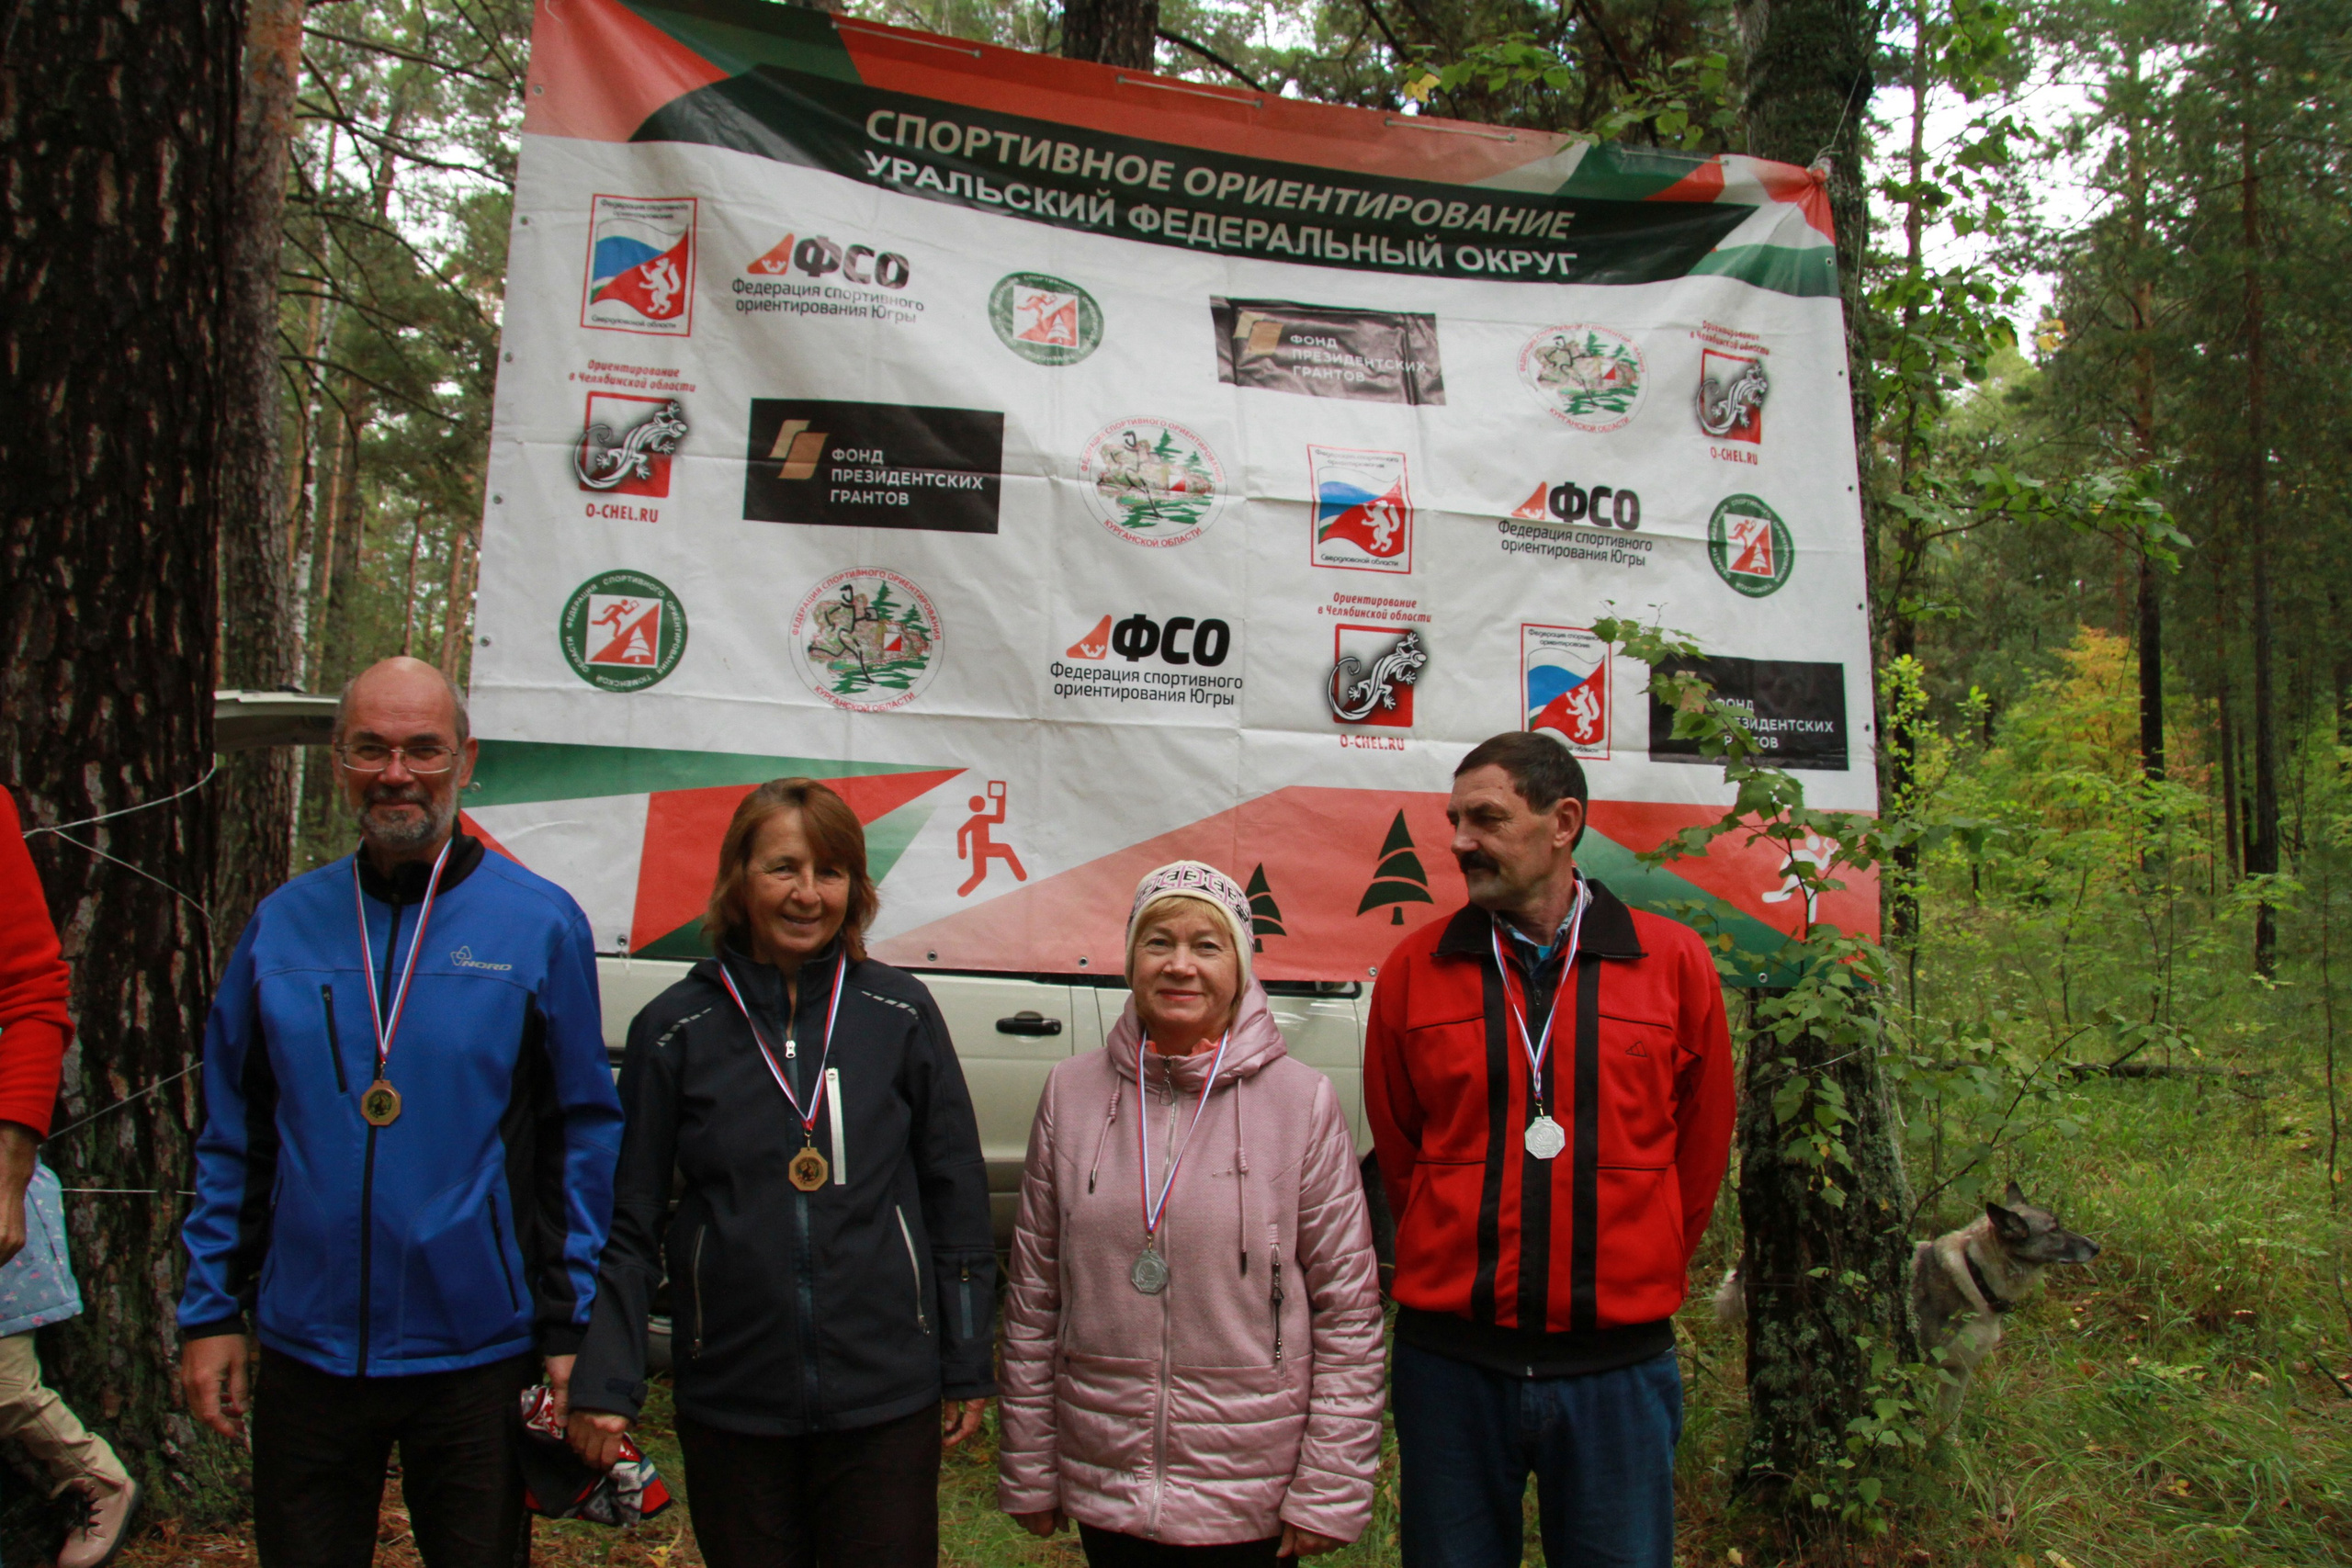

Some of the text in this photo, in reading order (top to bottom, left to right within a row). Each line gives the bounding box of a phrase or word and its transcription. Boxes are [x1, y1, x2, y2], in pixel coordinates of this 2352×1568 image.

[866, 109, 1576, 240] СПОРТИВНОЕ ОРИЕНТИРОВАНИЕ
[864, 149, 1577, 276] УРАЛЬСКИЙ ФЕДЕРАЛЬНЫЙ ОКРУГ
[794, 234, 910, 289] ФСО
[732, 277, 924, 311] Федерация спортивного
[736, 299, 917, 324] ориентирования Югры
[1290, 334, 1338, 350] ФОНД
[588, 359, 680, 377] Ориентирование
[1292, 349, 1427, 373] ПРЕЗИДЕНТСКИХ
[569, 372, 696, 392] в Челябинской области
[1292, 366, 1366, 382] ГРАНТОВ
[1105, 418, 1167, 434] СПОРТИВНОГО
[831, 448, 884, 465] ФОНД
[1710, 446, 1758, 465] O-CHEL.RU
[831, 468, 983, 491] ПРЕЗИДЕНТСКИХ
[830, 490, 910, 505] ГРАНТОВ
[1548, 481, 1641, 531] ФСО
[585, 502, 659, 523] O-CHEL.RU
[1104, 519, 1203, 547] КУРГАНСКОЙ ОБЛАСТИ
[1498, 519, 1653, 552] Федерация спортивного
[1371, 558, 1398, 566] области
[1501, 539, 1645, 569] ориентирования Югры
[792, 569, 941, 640] ФЕДЕРАЦИЯ СПОРТИВНОГО ОРИЕНТИРОВАНИЯ
[1333, 592, 1417, 608] Ориентирование
[566, 575, 682, 674] ФЕДЕРАЦИЯ СПОРТИВНОГО ОРИЕНТИРОВАНИЯ
[1317, 605, 1432, 623] в Челябинской области
[1112, 614, 1230, 667] ФСО
[566, 636, 652, 687] ТЮМЕНСКОЙ ОБЛАСТИ
[1050, 661, 1243, 689] Федерация спортивного
[814, 685, 916, 713] КУРГАНСКОЙ ОБЛАСТИ
[1054, 682, 1235, 707] ориентирования Югры
[1340, 734, 1406, 751] O-CHEL.RU
[461, 960, 513, 971] NORD
